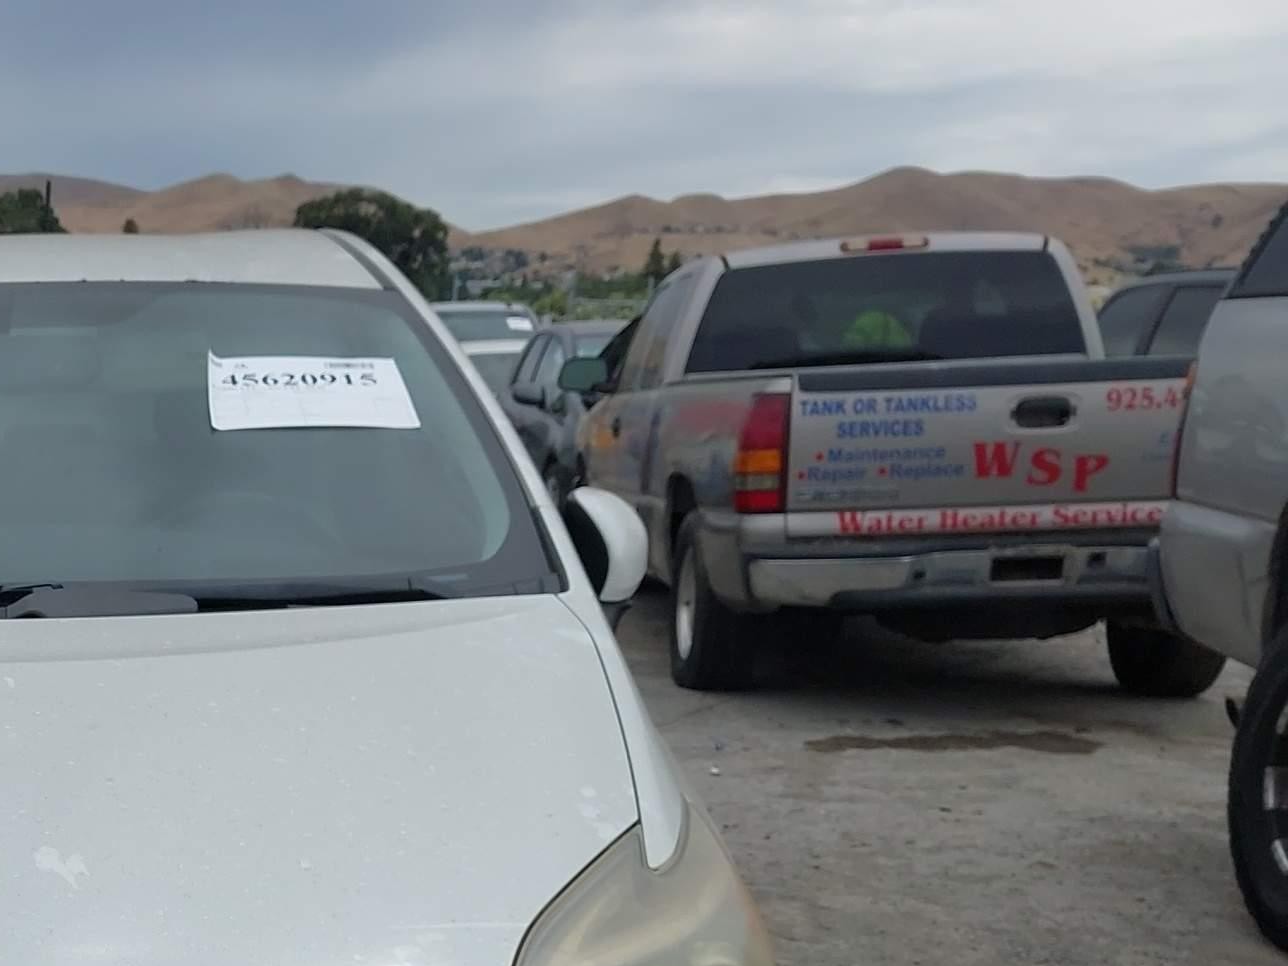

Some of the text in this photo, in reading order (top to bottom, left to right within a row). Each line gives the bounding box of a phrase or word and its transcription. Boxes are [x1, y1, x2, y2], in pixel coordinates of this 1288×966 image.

[222, 371, 377, 387] 45620915
[800, 394, 977, 415] TANK OR TANKLESS
[1105, 386, 1188, 412] 925.4
[837, 418, 924, 438] SERVICES
[827, 447, 946, 463] Maintenance
[807, 463, 965, 483] Repair Replace
[972, 439, 1110, 494] WSP
[834, 509, 928, 535] Water
[936, 504, 1040, 530] Heater
